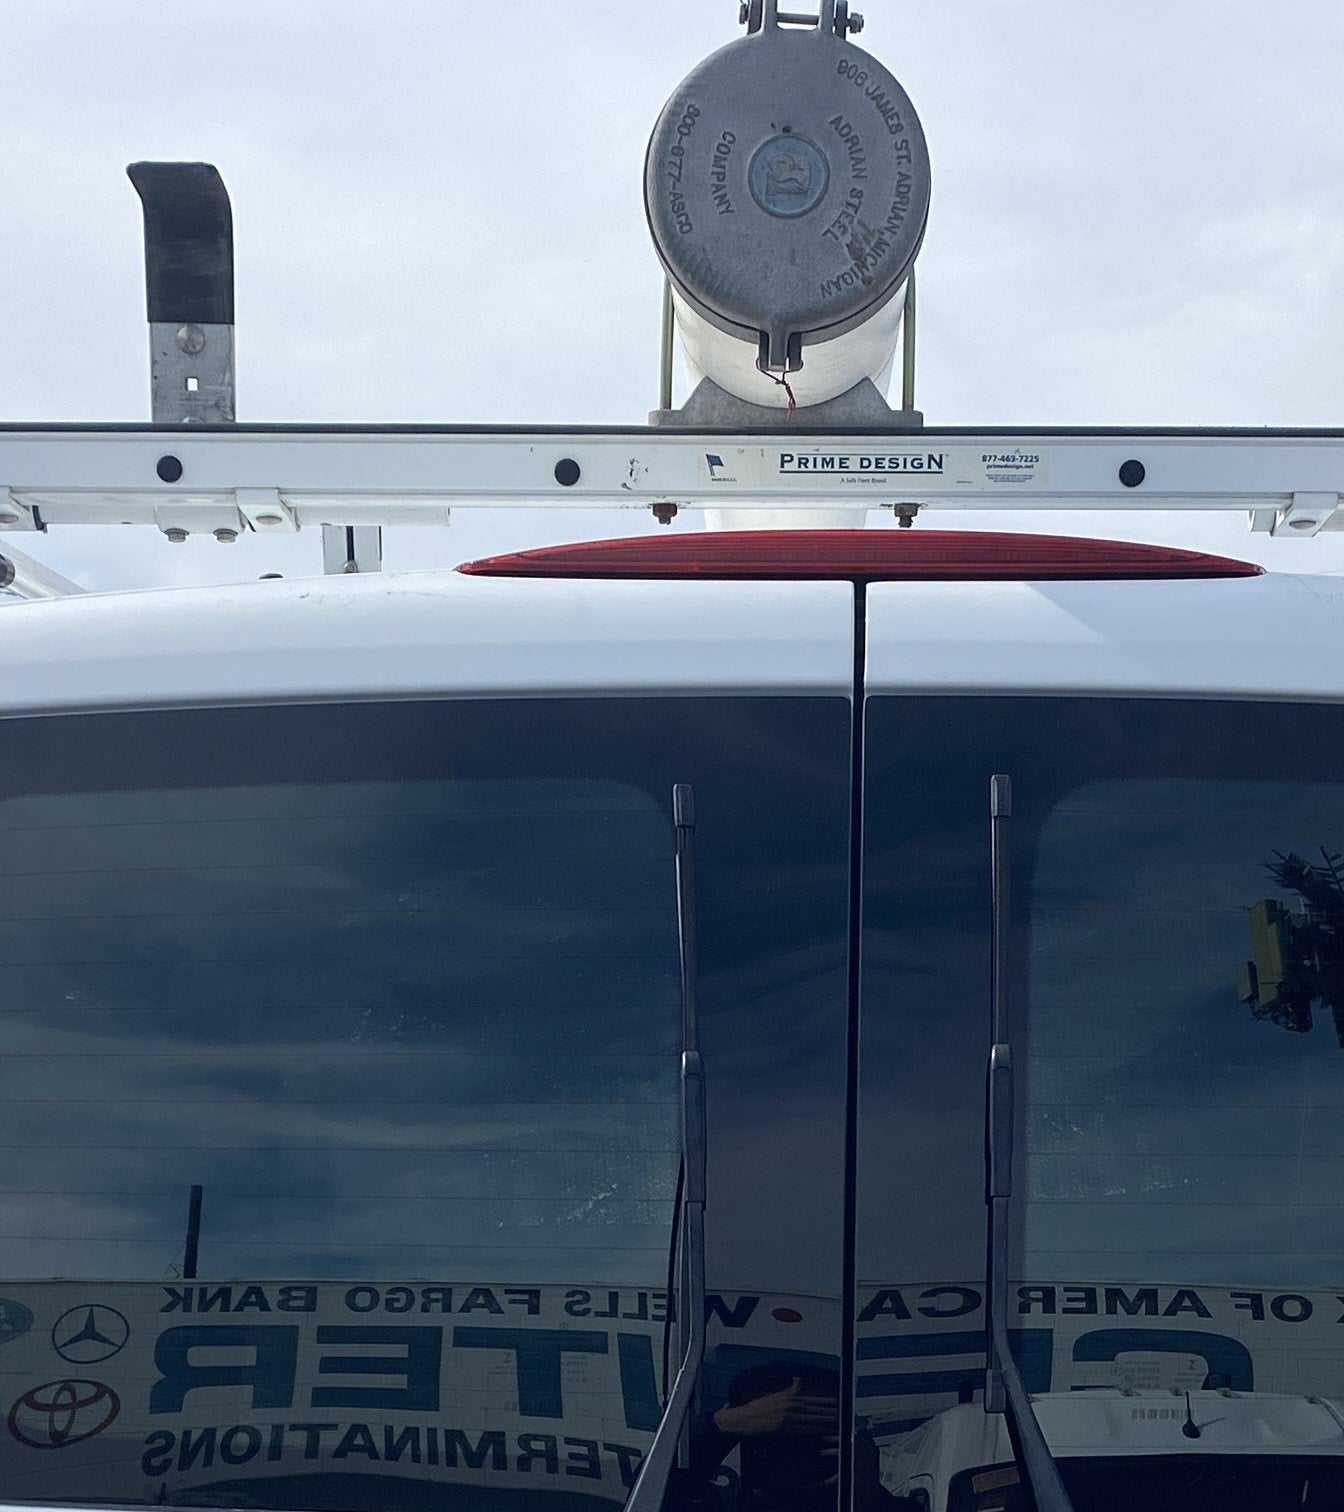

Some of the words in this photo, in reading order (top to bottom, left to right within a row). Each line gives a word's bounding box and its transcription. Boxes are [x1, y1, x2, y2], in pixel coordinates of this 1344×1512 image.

[864, 85, 905, 135] JAMES
[710, 130, 737, 216] COMPANY
[828, 114, 868, 180] ADRIAN
[821, 186, 865, 241] STEEL
[779, 453, 850, 469] PRIME
[859, 453, 944, 470] DESIGN
[981, 454, 1040, 463] 877-463-7225
